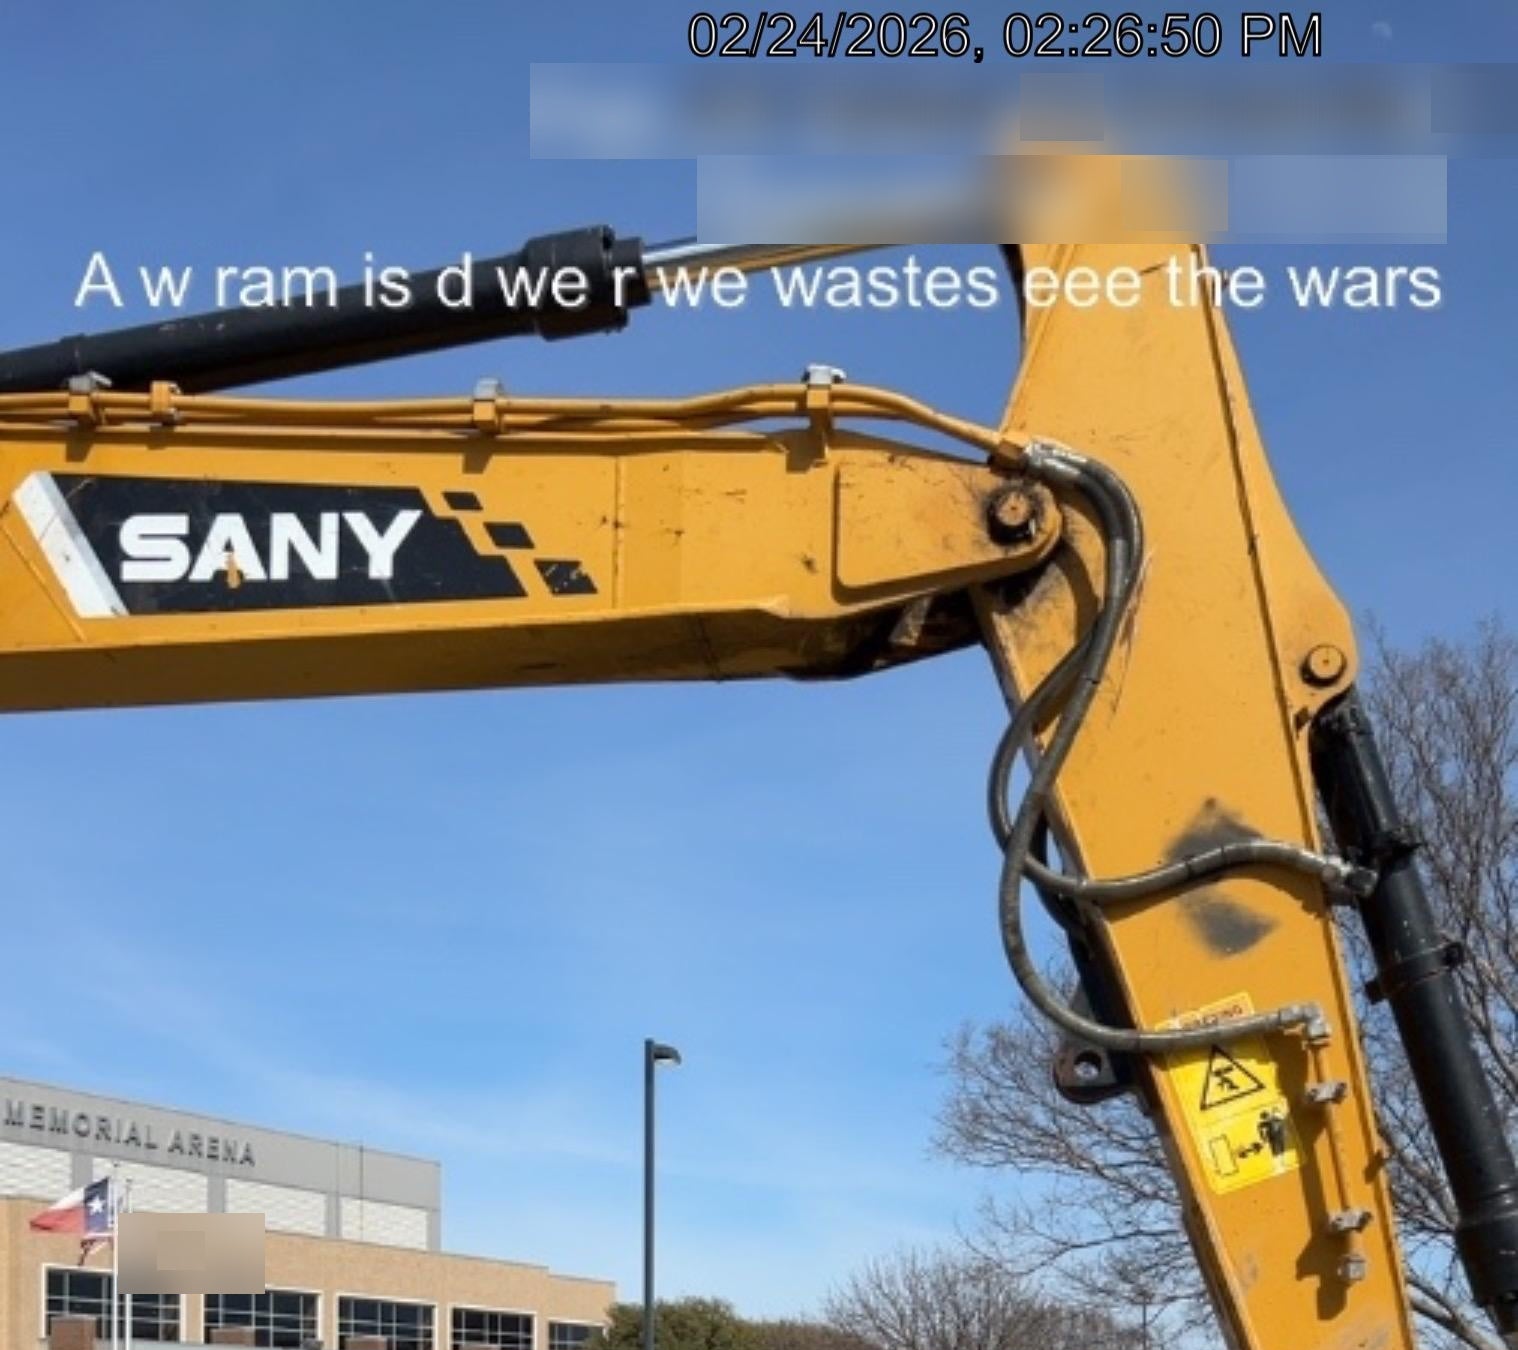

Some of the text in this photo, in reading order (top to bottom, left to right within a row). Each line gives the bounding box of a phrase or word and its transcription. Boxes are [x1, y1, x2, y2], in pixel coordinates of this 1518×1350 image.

[119, 508, 423, 583] SANY
[3, 1099, 257, 1168] MEMORIAL ARENA
